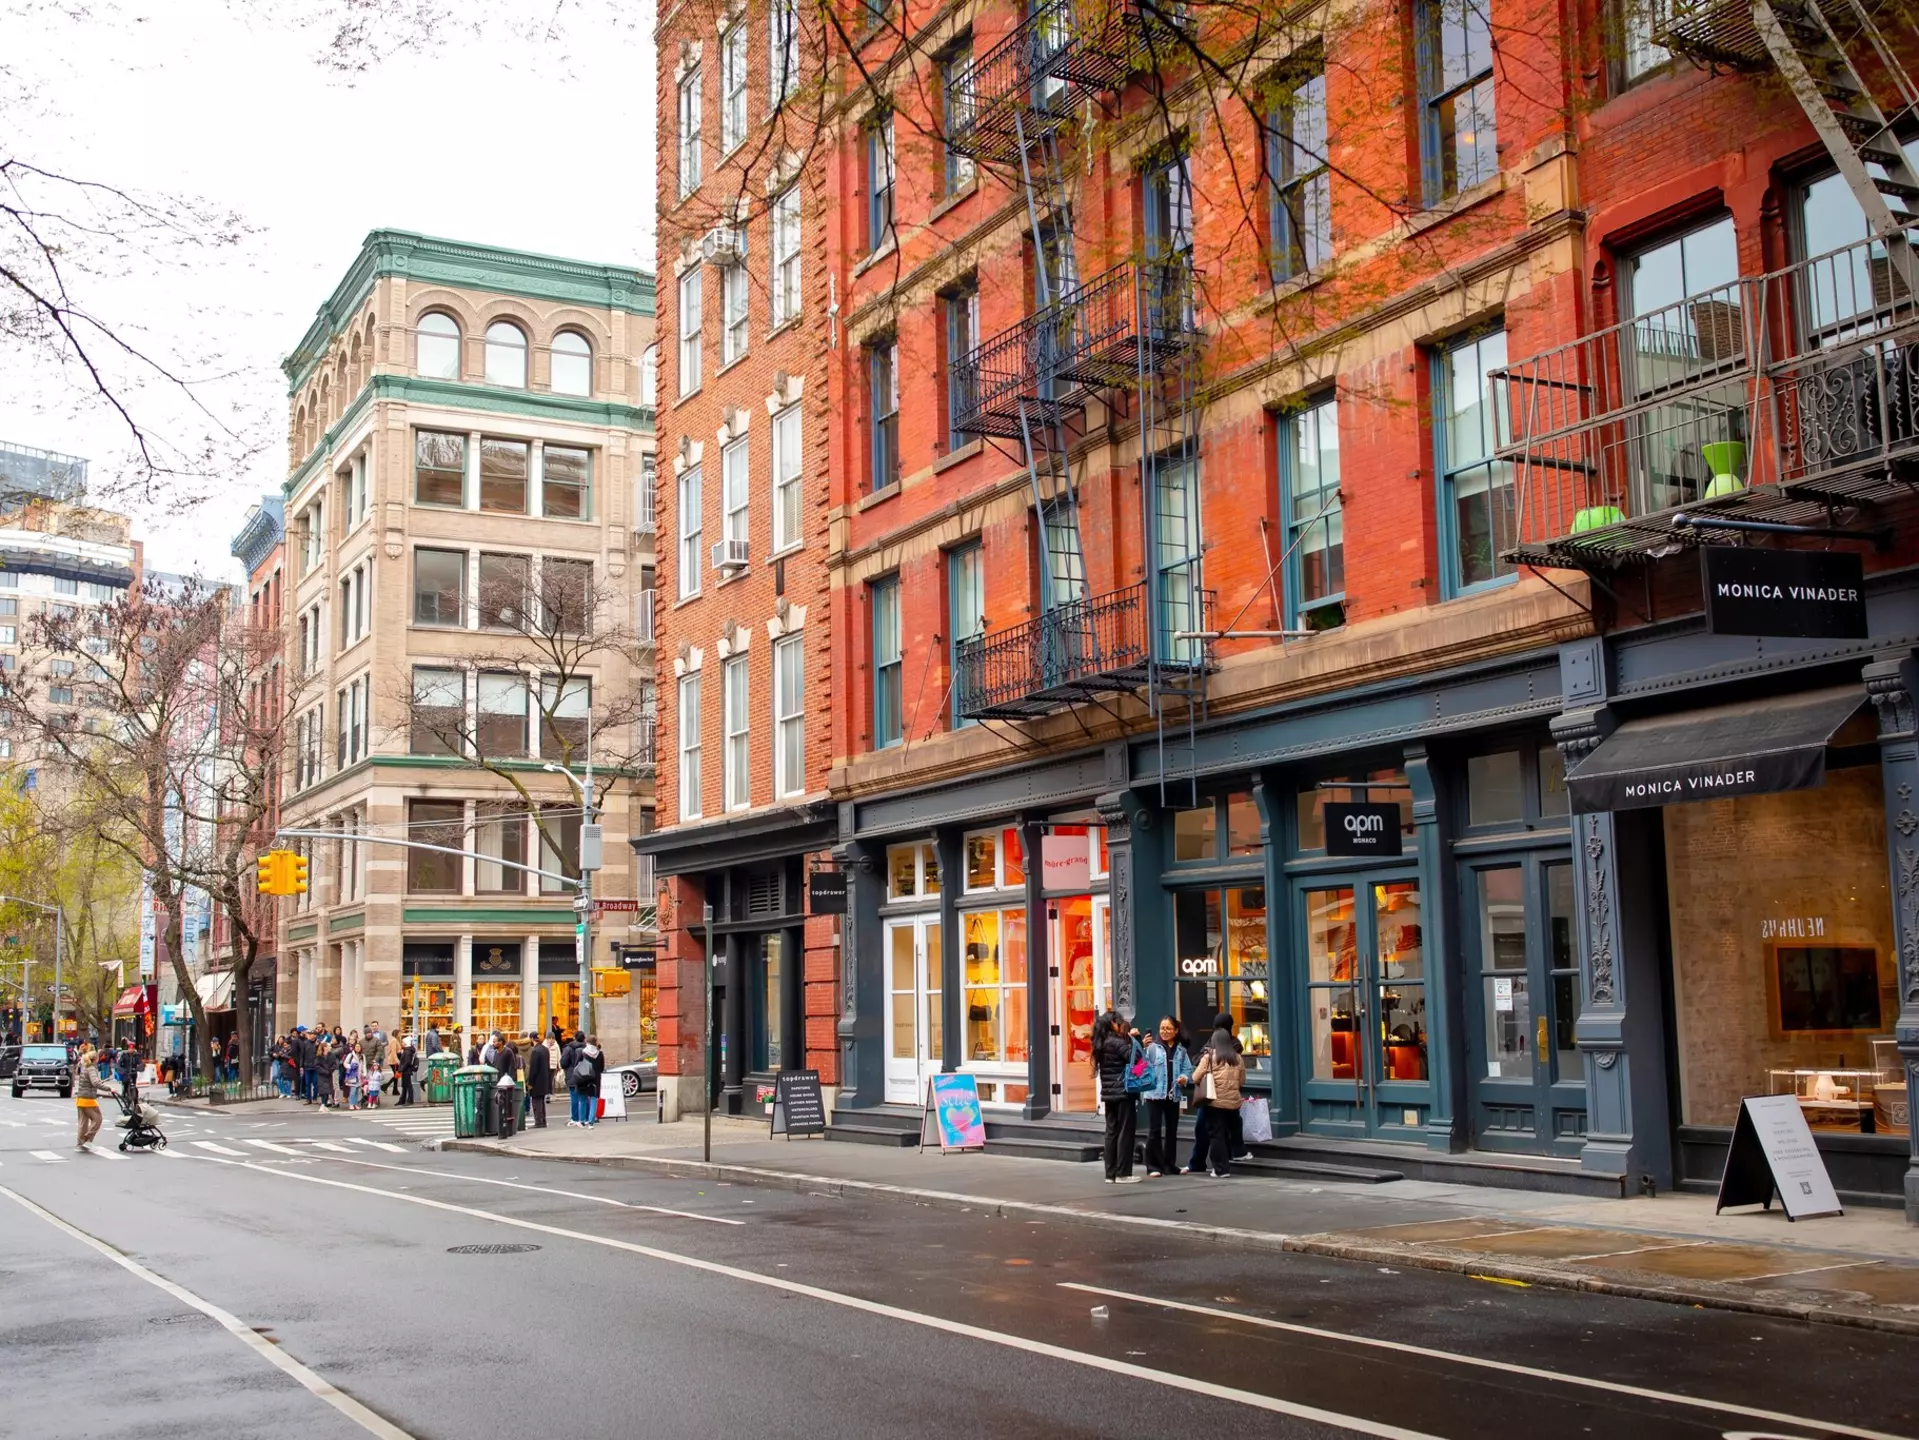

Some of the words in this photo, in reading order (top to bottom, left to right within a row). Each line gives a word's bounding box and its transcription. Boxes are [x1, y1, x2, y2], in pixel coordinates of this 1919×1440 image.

[1717, 583, 1783, 599] MONICA
[1789, 586, 1858, 602] VINADER
[1625, 780, 1682, 797] MONICA
[1688, 770, 1755, 789] VINADER
[1344, 814, 1384, 837] apm
[811, 889, 846, 897] topdrawer
[602, 901, 636, 912] Broadway
[1182, 958, 1218, 978] apm
[781, 1074, 818, 1082] topdrawer
